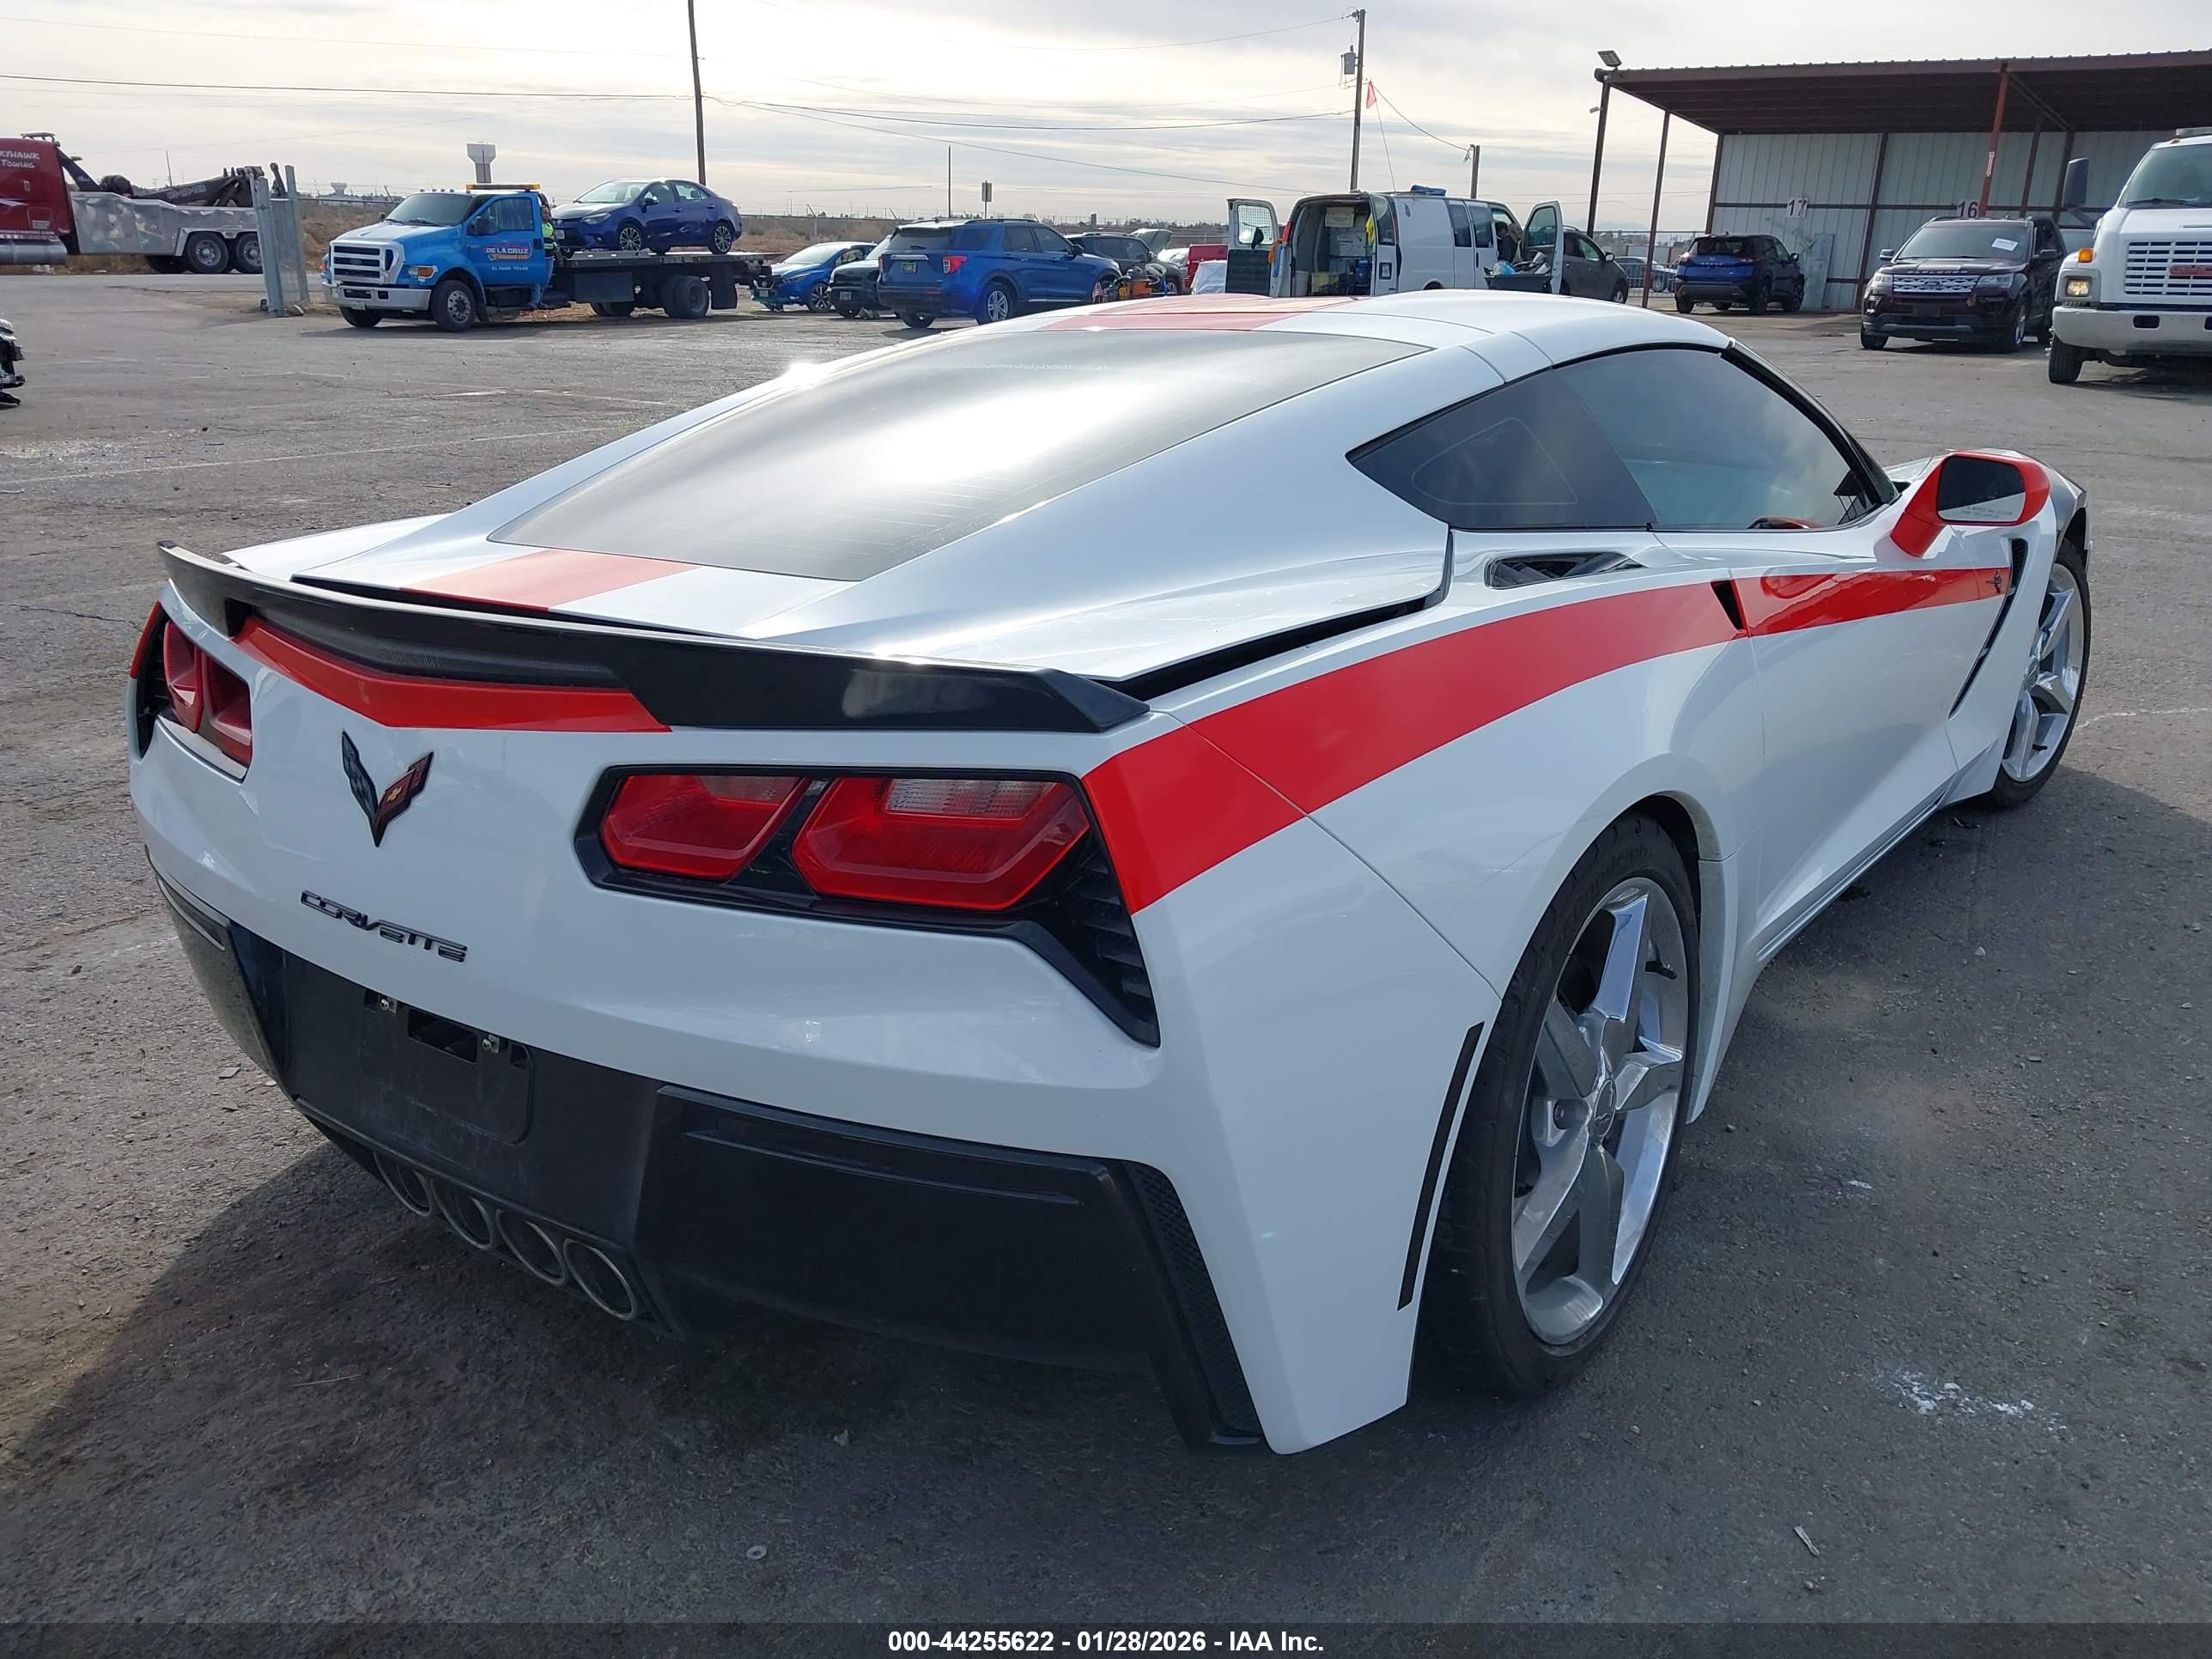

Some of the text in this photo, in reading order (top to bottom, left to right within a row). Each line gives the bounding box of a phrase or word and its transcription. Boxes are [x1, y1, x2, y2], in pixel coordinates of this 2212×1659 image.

[0, 159, 35, 168] TOWING
[1788, 198, 1808, 216] 17
[1958, 200, 1978, 218] 16
[301, 889, 469, 963] CORVETTE
